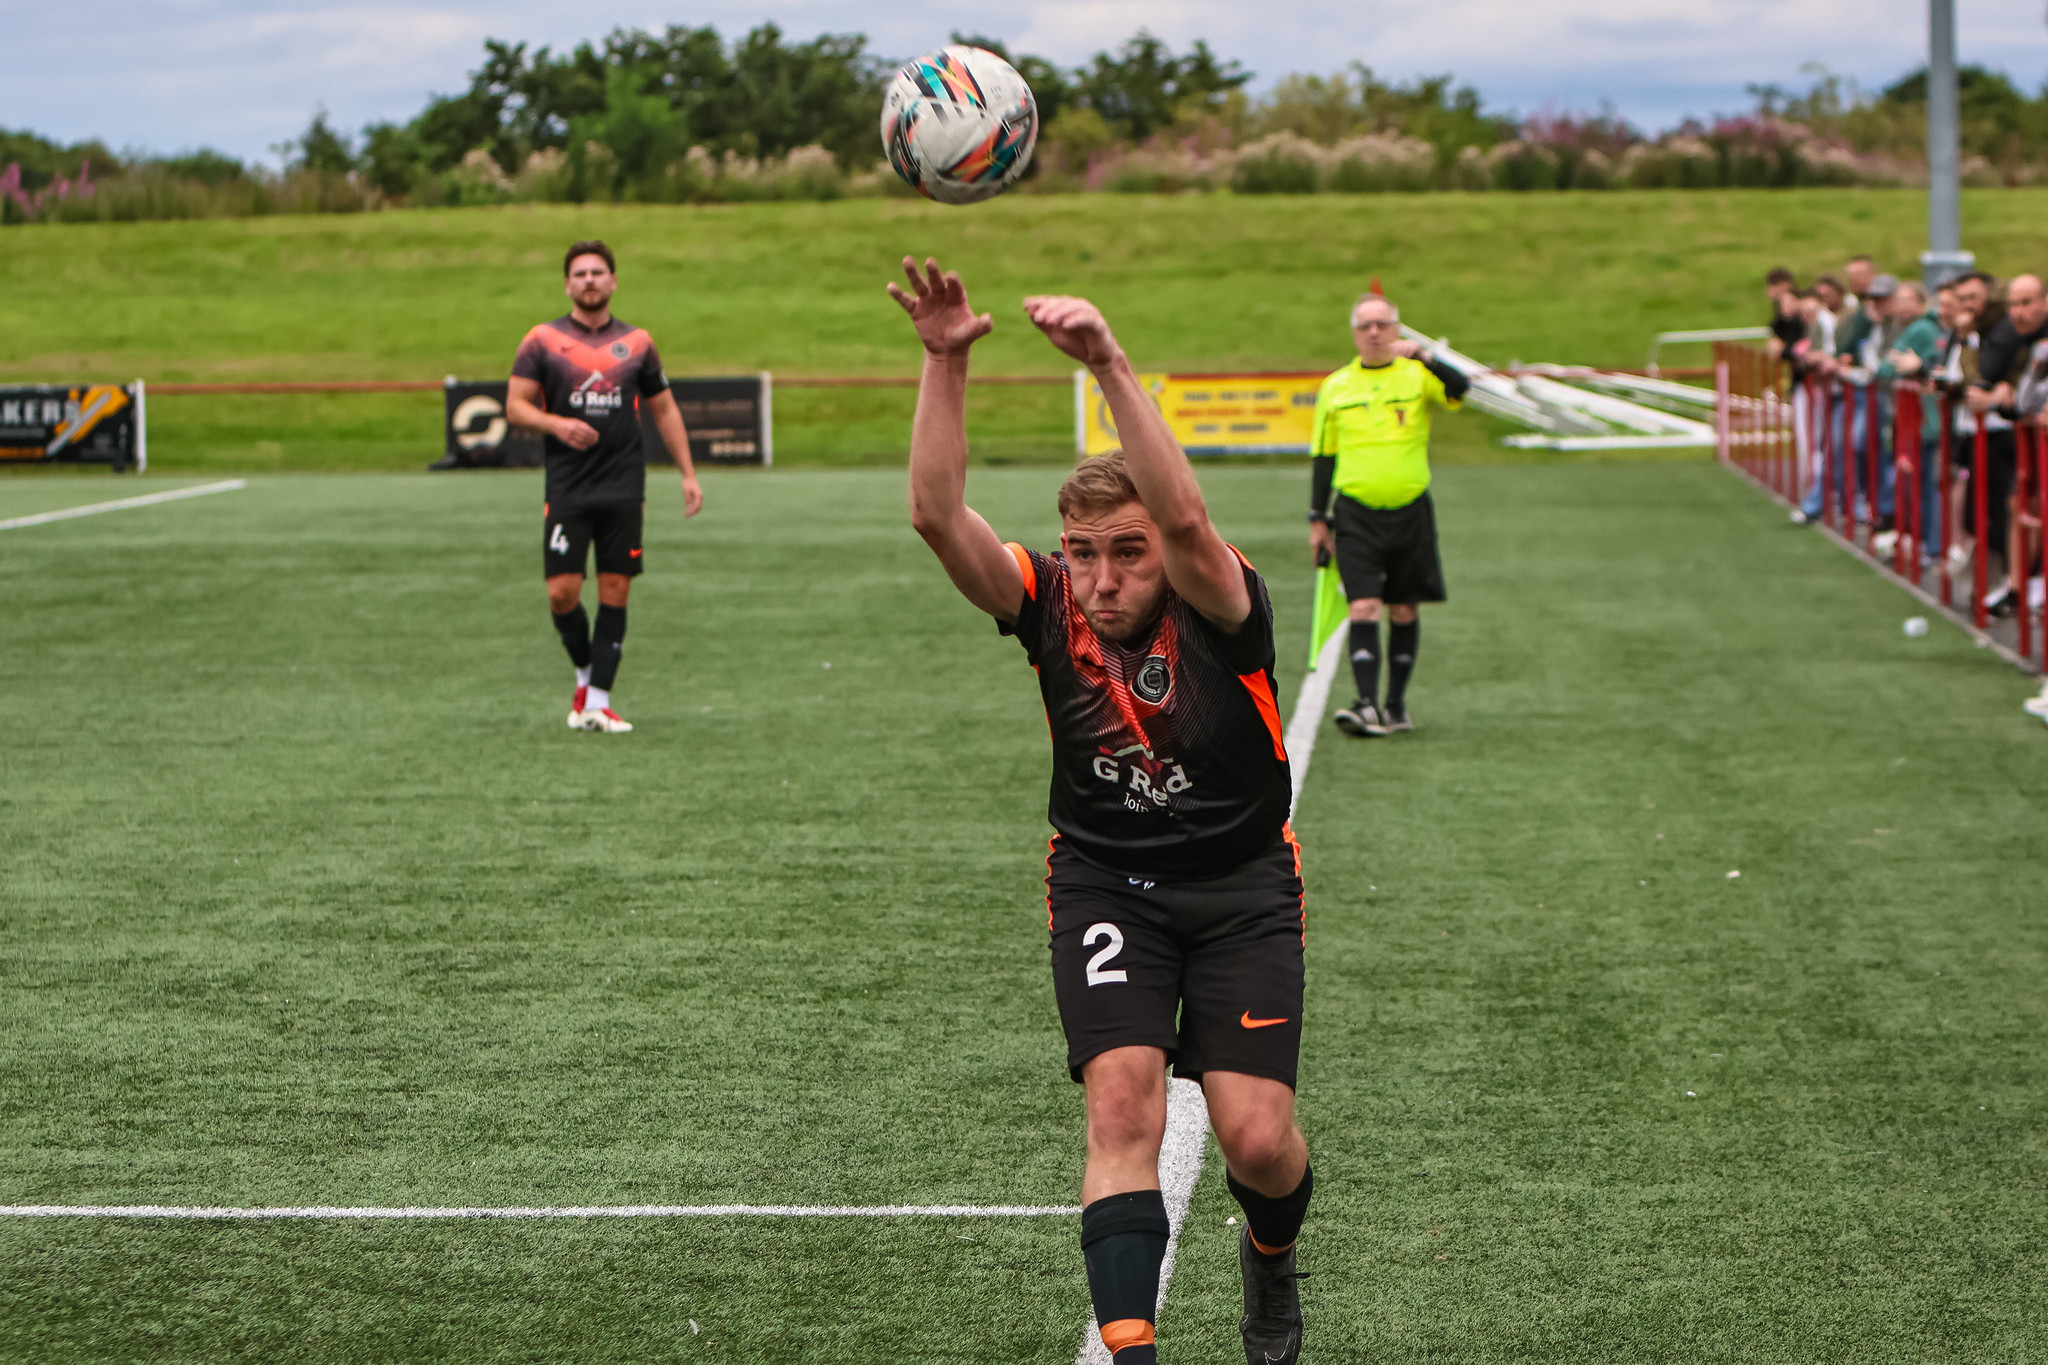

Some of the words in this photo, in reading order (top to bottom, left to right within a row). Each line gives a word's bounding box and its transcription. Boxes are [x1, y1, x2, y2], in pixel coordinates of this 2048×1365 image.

[0, 400, 80, 424] KERS
[569, 391, 583, 407] G
[550, 524, 569, 554] 4
[1093, 756, 1119, 783] G
[1129, 764, 1193, 807] Red
[1083, 922, 1128, 987] 2
